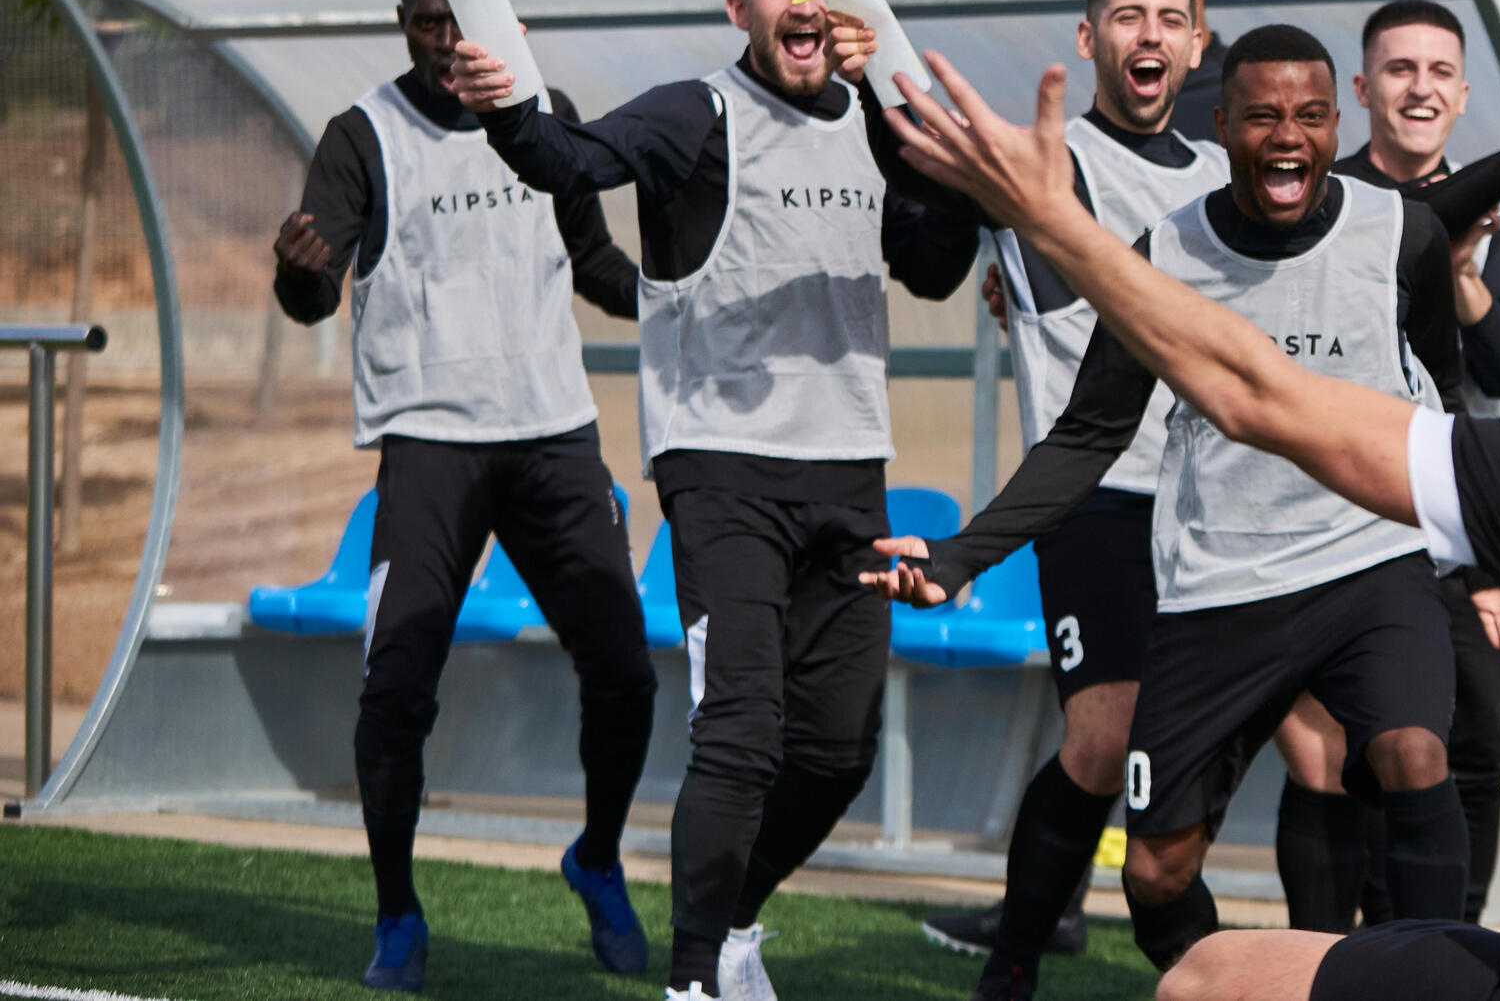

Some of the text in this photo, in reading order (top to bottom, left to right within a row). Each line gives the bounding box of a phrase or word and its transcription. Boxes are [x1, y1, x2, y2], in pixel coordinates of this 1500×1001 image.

[431, 186, 534, 214] KIPSTA
[781, 188, 876, 212] KIPSTA
[1268, 334, 1344, 357] STA
[1055, 614, 1085, 673] 3
[1126, 750, 1152, 811] 0
